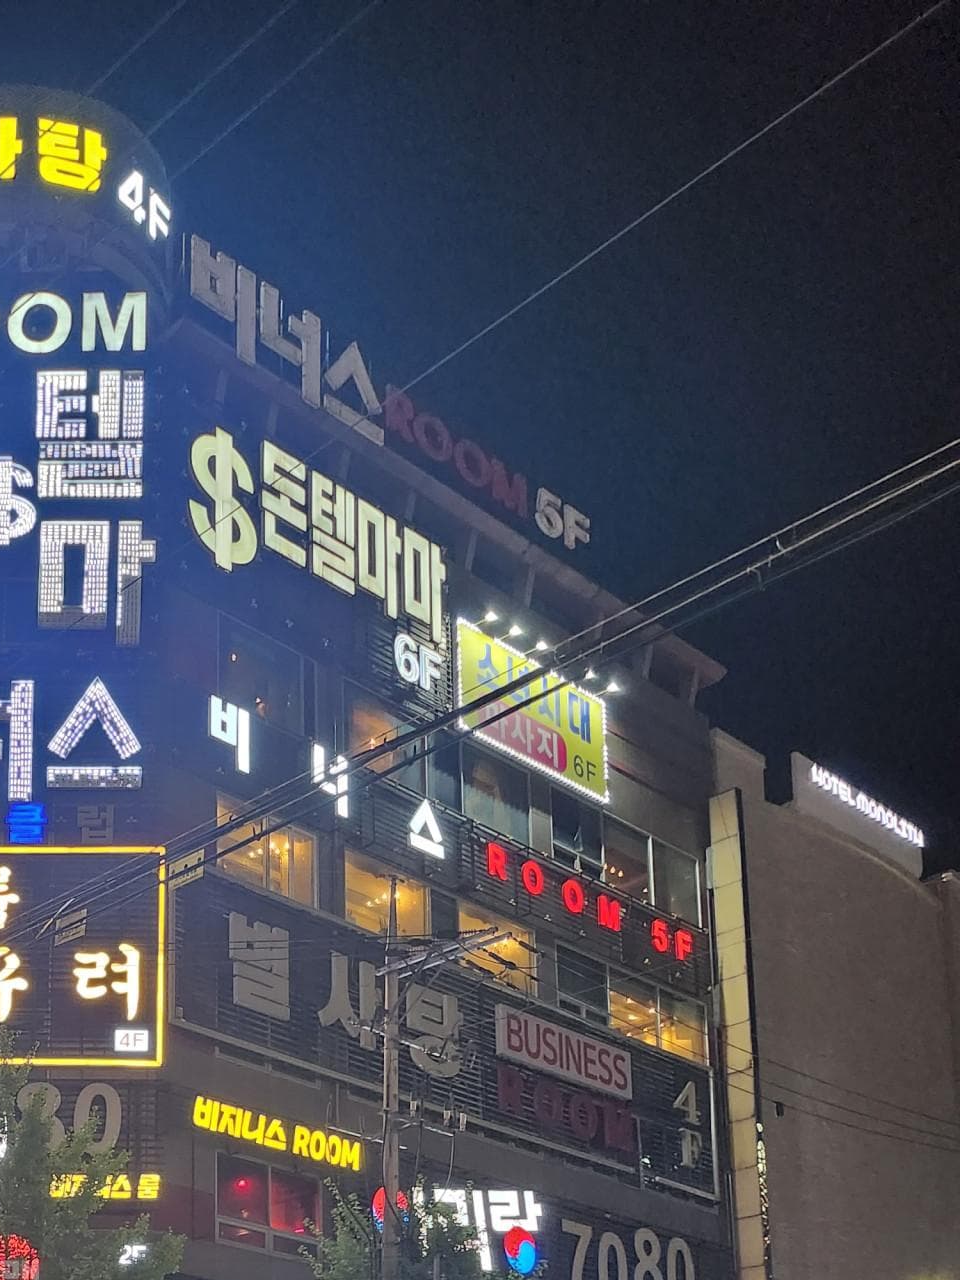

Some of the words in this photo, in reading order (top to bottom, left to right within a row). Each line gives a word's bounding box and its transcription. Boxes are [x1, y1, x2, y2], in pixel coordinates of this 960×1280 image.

[118, 169, 171, 241] 4F
[190, 233, 385, 447] 비너스
[534, 487, 592, 551] 5F
[393, 632, 443, 692] 6F
[572, 753, 597, 783] 6F
[209, 694, 447, 861] 비너스
[486, 841, 623, 933] ROOM
[649, 917, 694, 962] 5F
[119, 1032, 145, 1048] 4F
[505, 1013, 629, 1090] BUSINESS
[193, 1095, 288, 1152] 비지니스
[292, 1124, 361, 1172] ROOM
